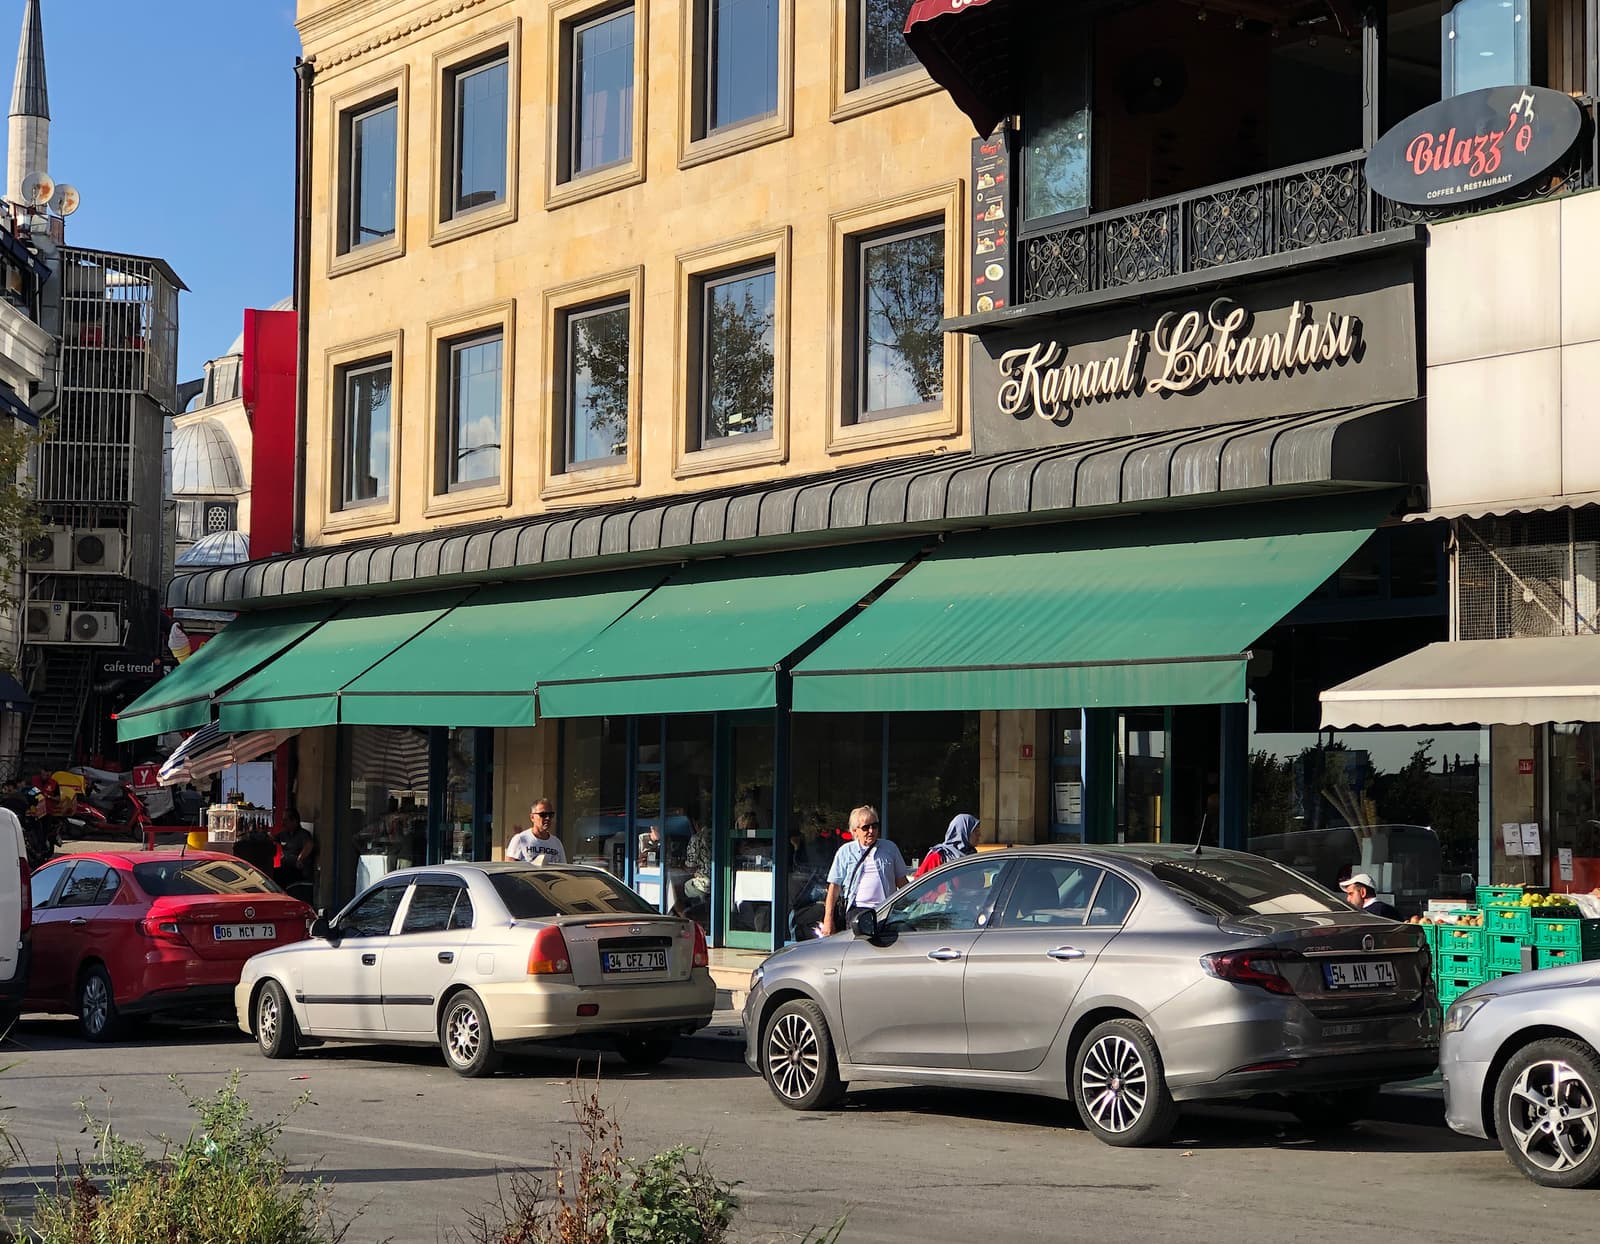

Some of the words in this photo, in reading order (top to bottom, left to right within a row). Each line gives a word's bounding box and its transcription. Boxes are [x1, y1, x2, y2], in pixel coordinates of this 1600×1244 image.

[1405, 111, 1532, 178] Bilazz'o
[1426, 185, 1455, 200] COFFEE
[1463, 173, 1513, 192] RESTAURANT
[998, 328, 1143, 420] Kanaat
[1147, 297, 1355, 393] Lokantası
[103, 660, 126, 673] cafe
[126, 661, 154, 673] trend
[221, 927, 232, 938] 06
[239, 926, 255, 938] MCY
[263, 926, 274, 937] 73
[609, 954, 621, 968] 34
[626, 953, 643, 967] CFZ
[648, 952, 664, 966] 718
[1331, 965, 1346, 983] 54
[1374, 963, 1393, 981] 174
